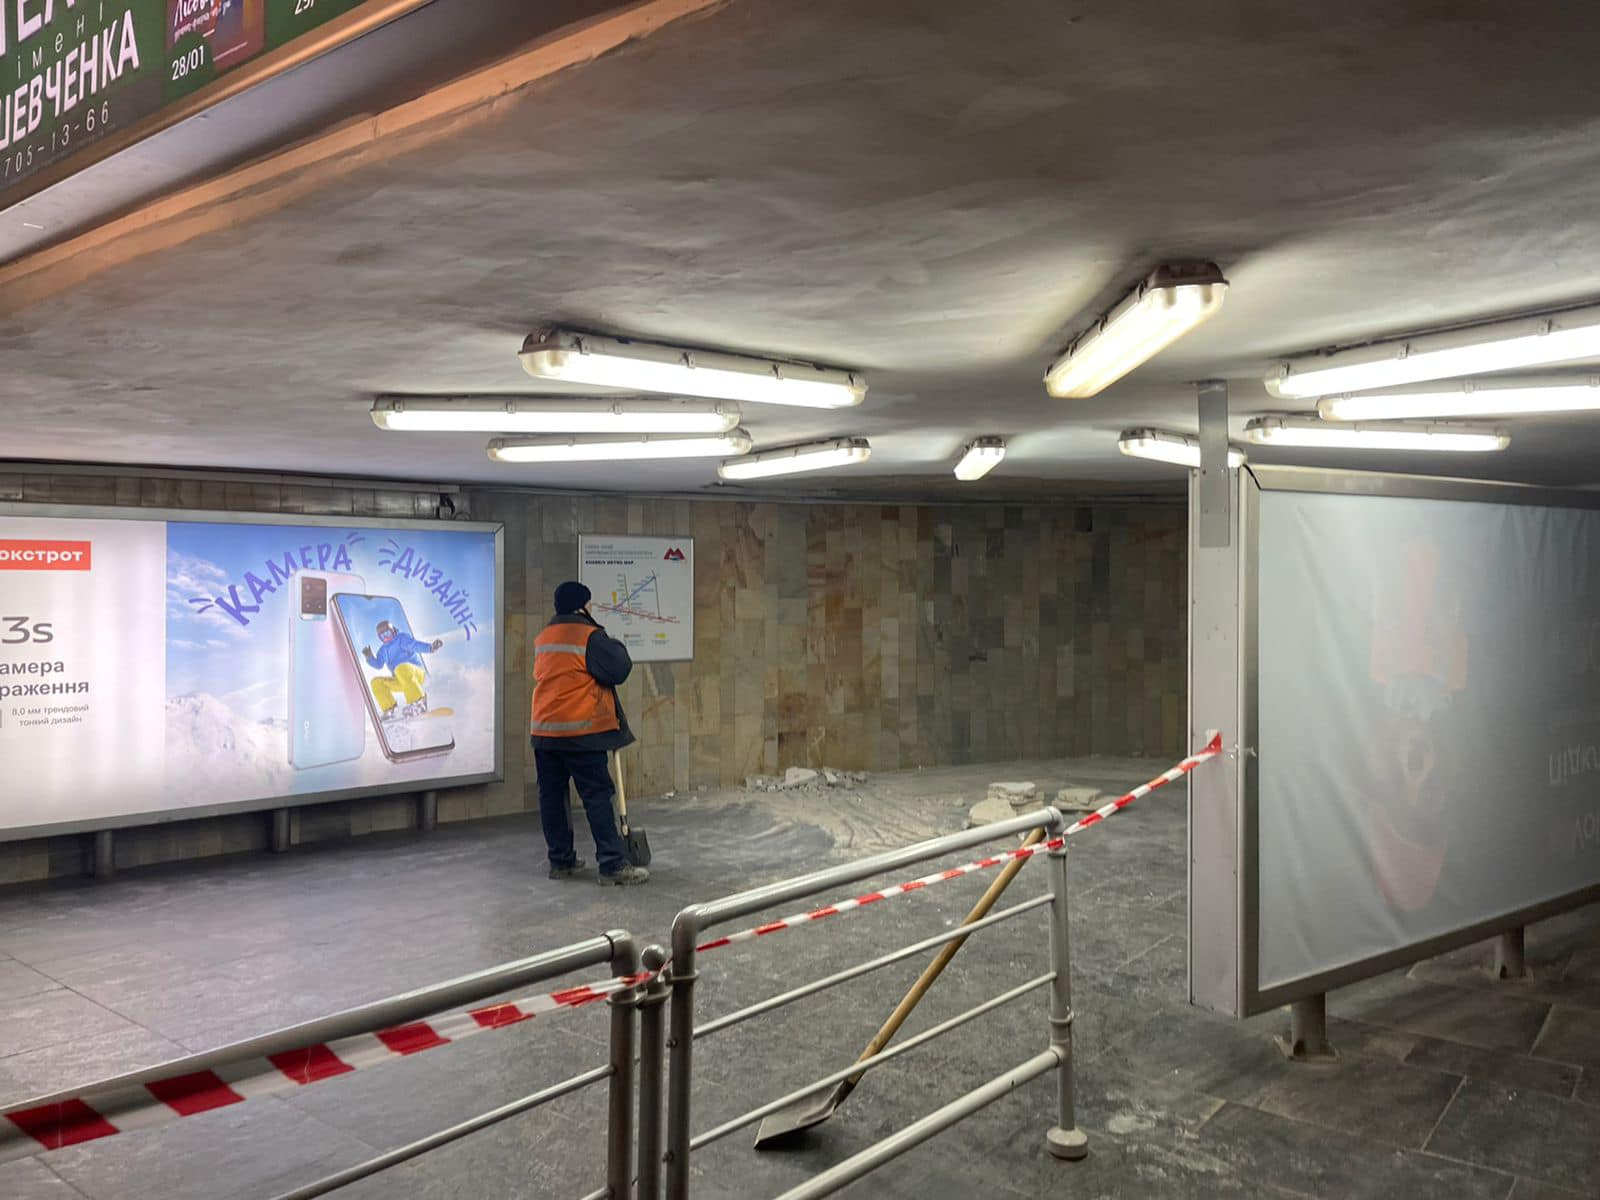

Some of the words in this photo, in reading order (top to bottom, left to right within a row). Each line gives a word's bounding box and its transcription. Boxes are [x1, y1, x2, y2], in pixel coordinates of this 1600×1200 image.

[171, 45, 205, 81] 28/01
[215, 543, 352, 626] КАМЕРА
[391, 547, 472, 625] ДИЗАЙН
[44, 704, 89, 715] трендовий
[51, 715, 82, 726] дизайн
